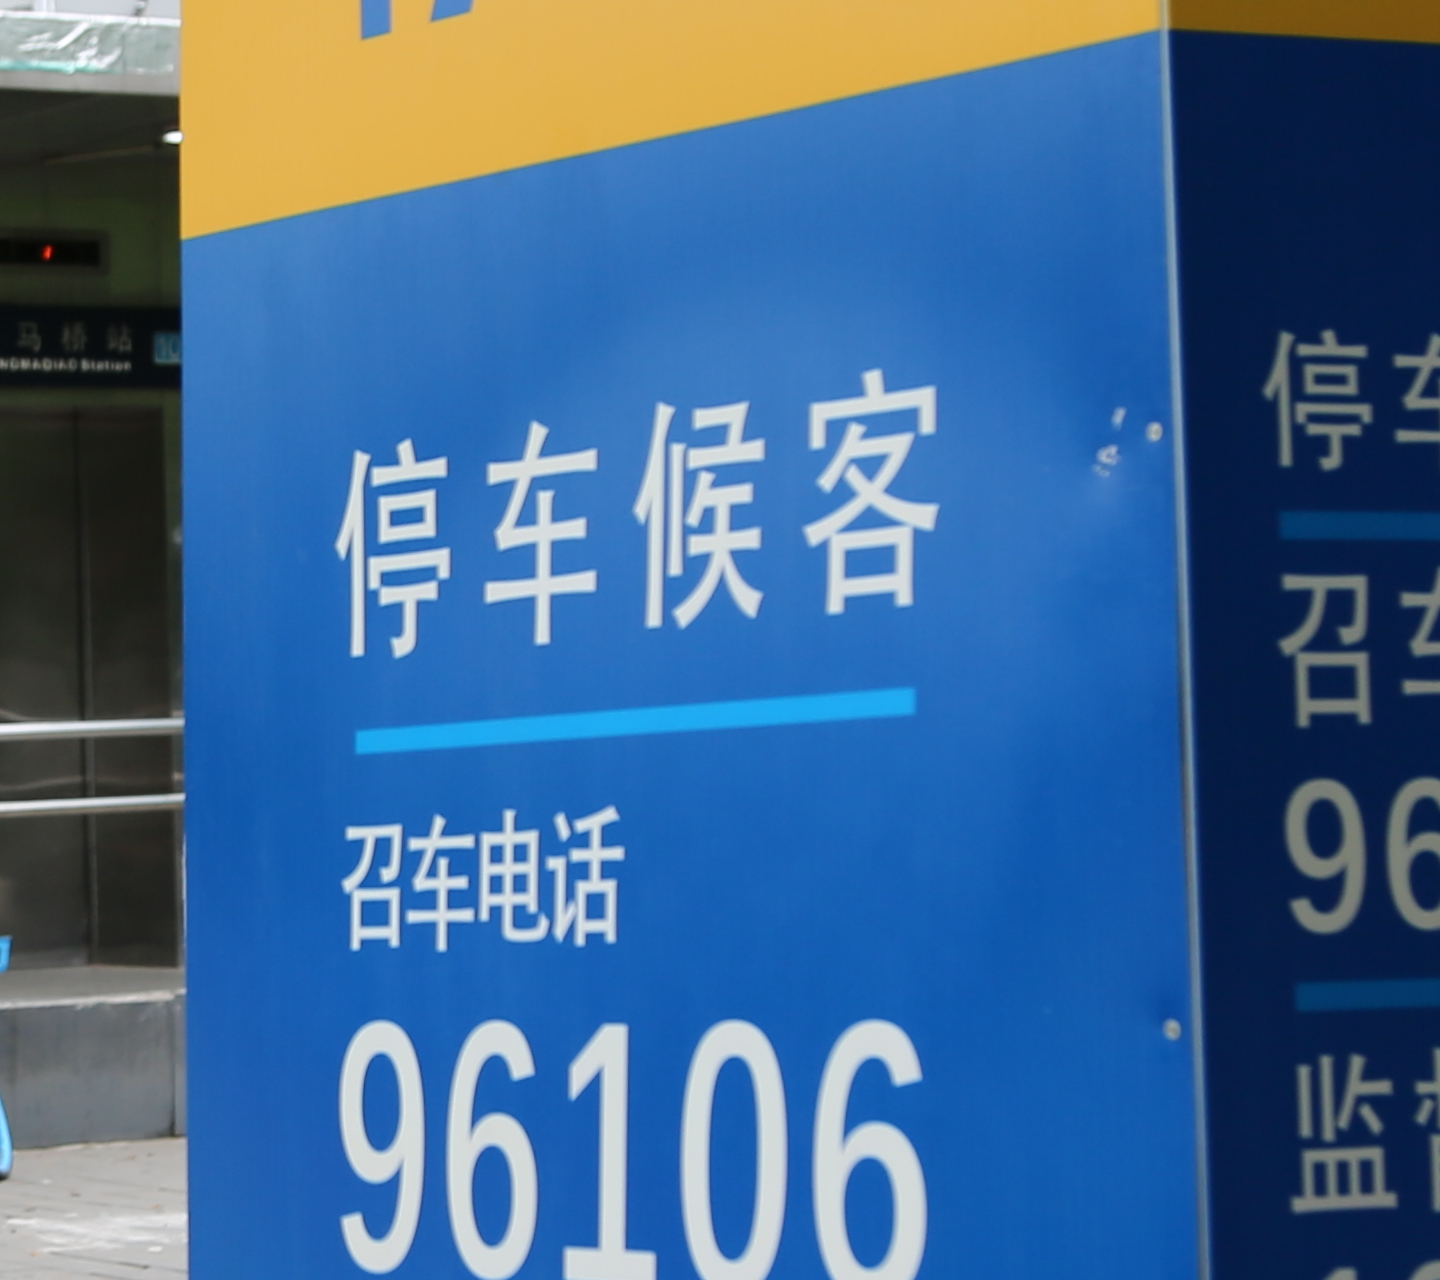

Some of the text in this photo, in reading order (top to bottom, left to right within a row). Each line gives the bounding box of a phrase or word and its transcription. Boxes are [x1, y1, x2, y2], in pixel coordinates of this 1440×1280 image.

[333, 368, 941, 661] 停车候客
[341, 806, 626, 955] 召车电话
